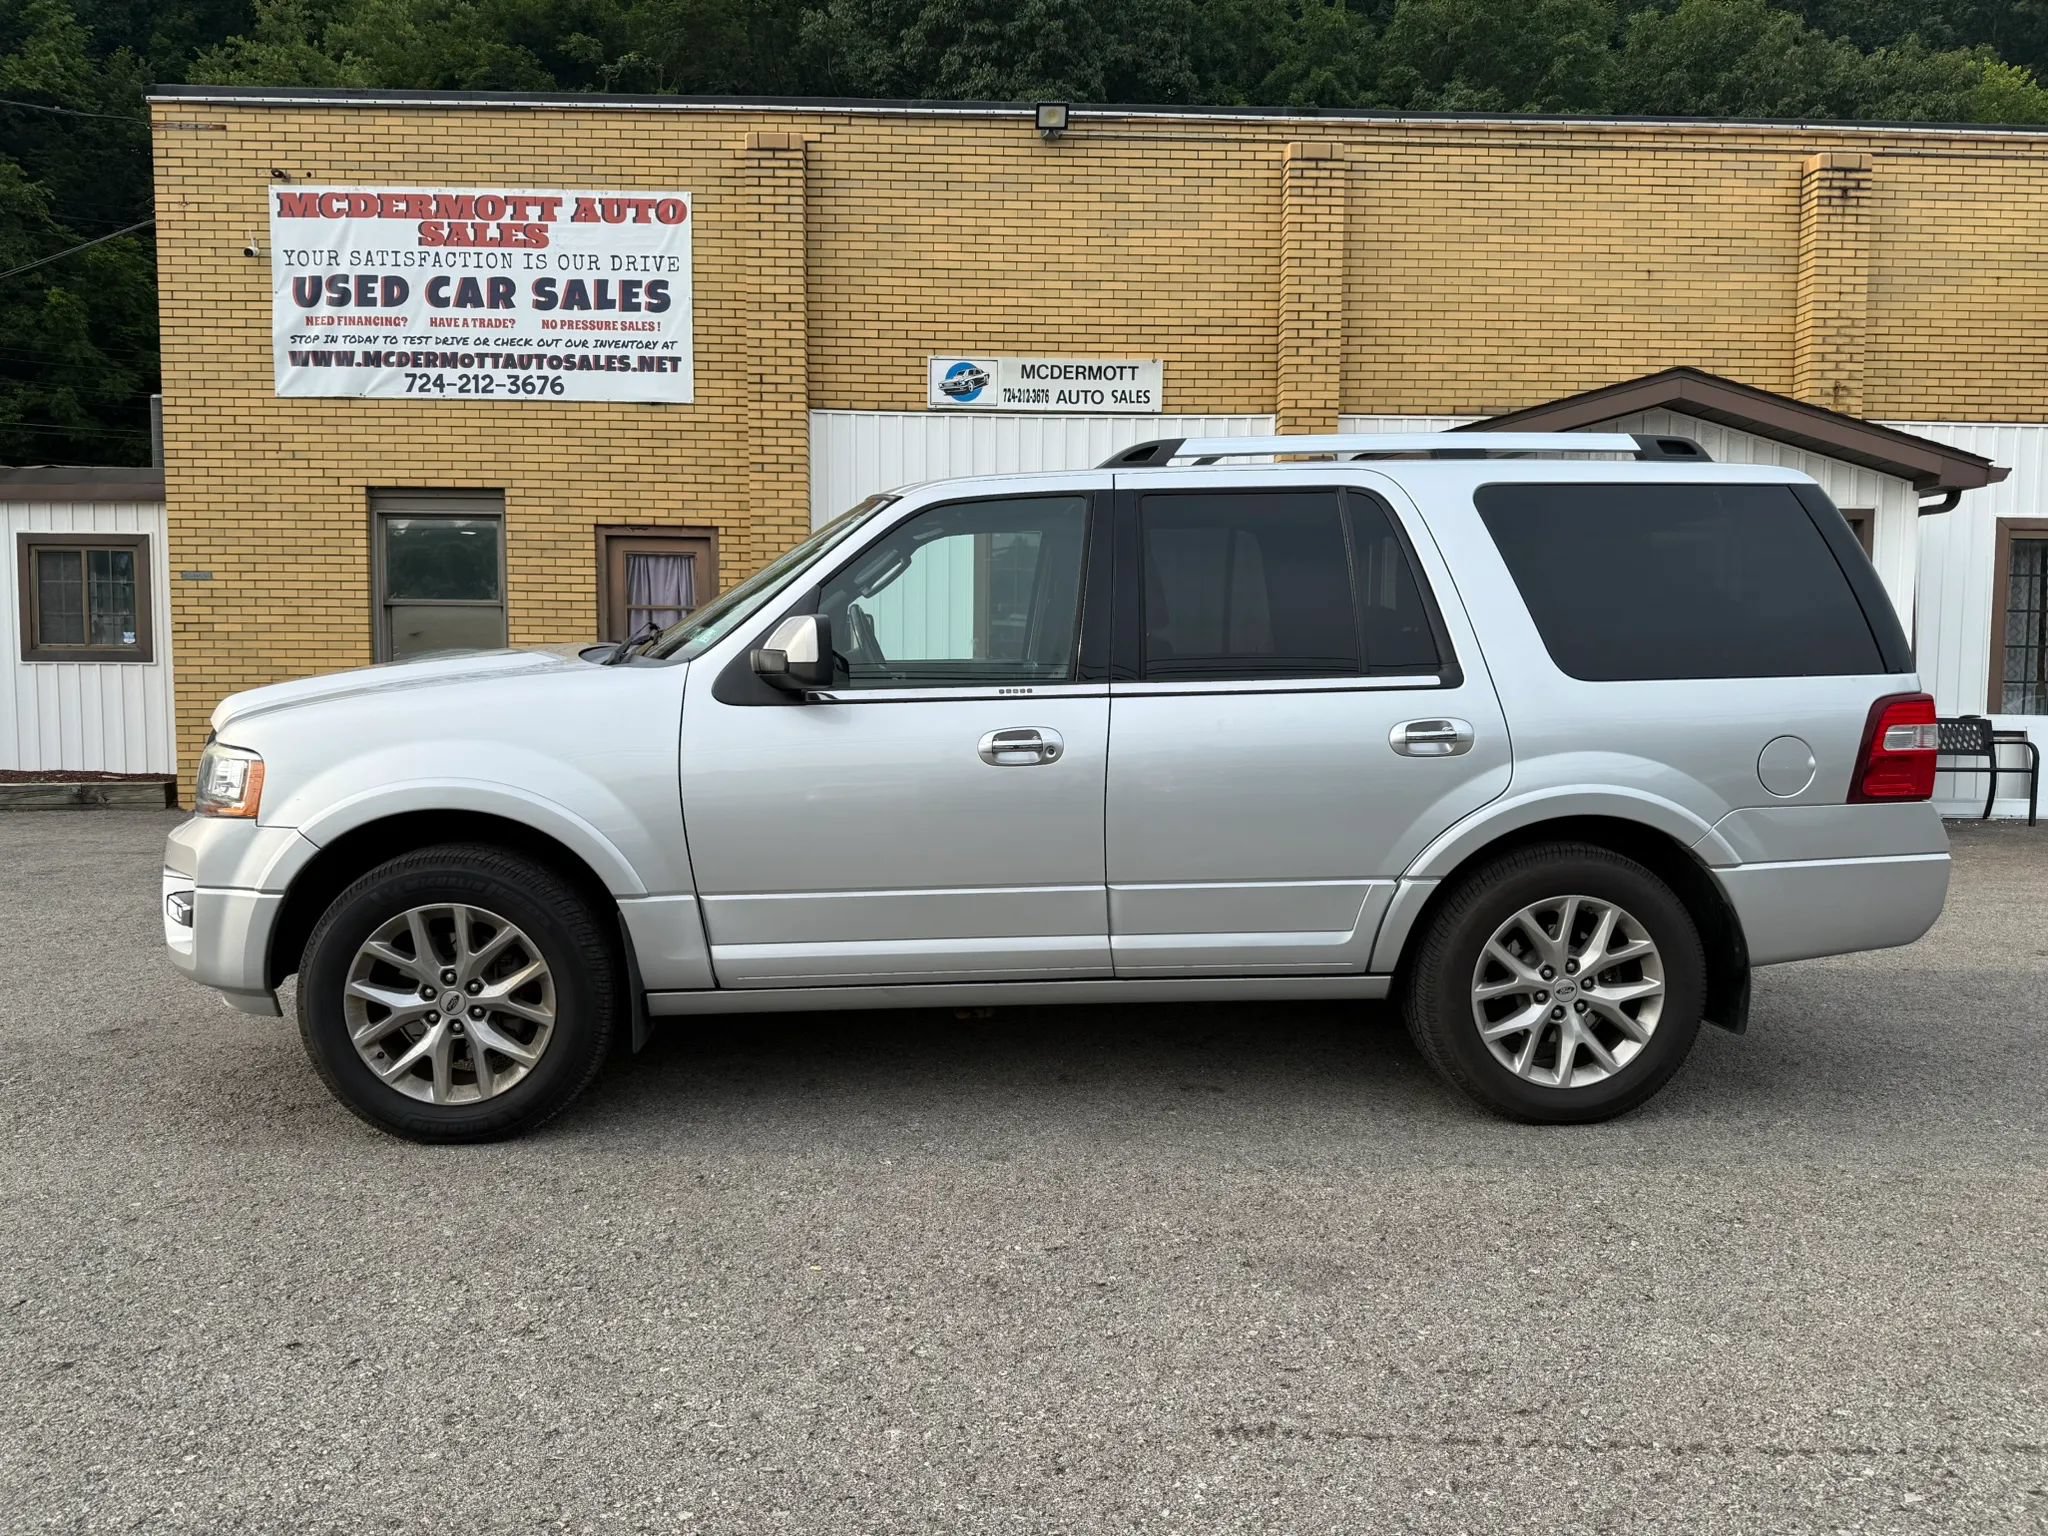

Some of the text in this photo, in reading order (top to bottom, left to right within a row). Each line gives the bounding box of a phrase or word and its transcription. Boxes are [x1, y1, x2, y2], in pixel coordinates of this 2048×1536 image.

[276, 192, 688, 225] MCDERMOTT AUTO
[417, 220, 549, 249] SALES
[283, 249, 680, 272] YOUR SATISFACTION IS OUR DRIVE
[292, 274, 671, 313] USED CAR SALES
[305, 316, 408, 328] NEED FINANCING?
[430, 317, 516, 329] HAVE A TRADE?
[541, 319, 557, 330] NO
[560, 319, 618, 332] PRESSURE
[290, 334, 678, 351] STOP IN TODAY TO TEST DRIVE OR CHECK OUT OUR INVENTORY AT
[288, 350, 682, 373] WWW.MCDERMOTTAUTOSALES.NET
[1020, 364, 1140, 381] MCDERMOTT
[404, 373, 565, 395] 724-212-3676
[1003, 388, 1151, 405] 724-212-3676 AUTO SALES
